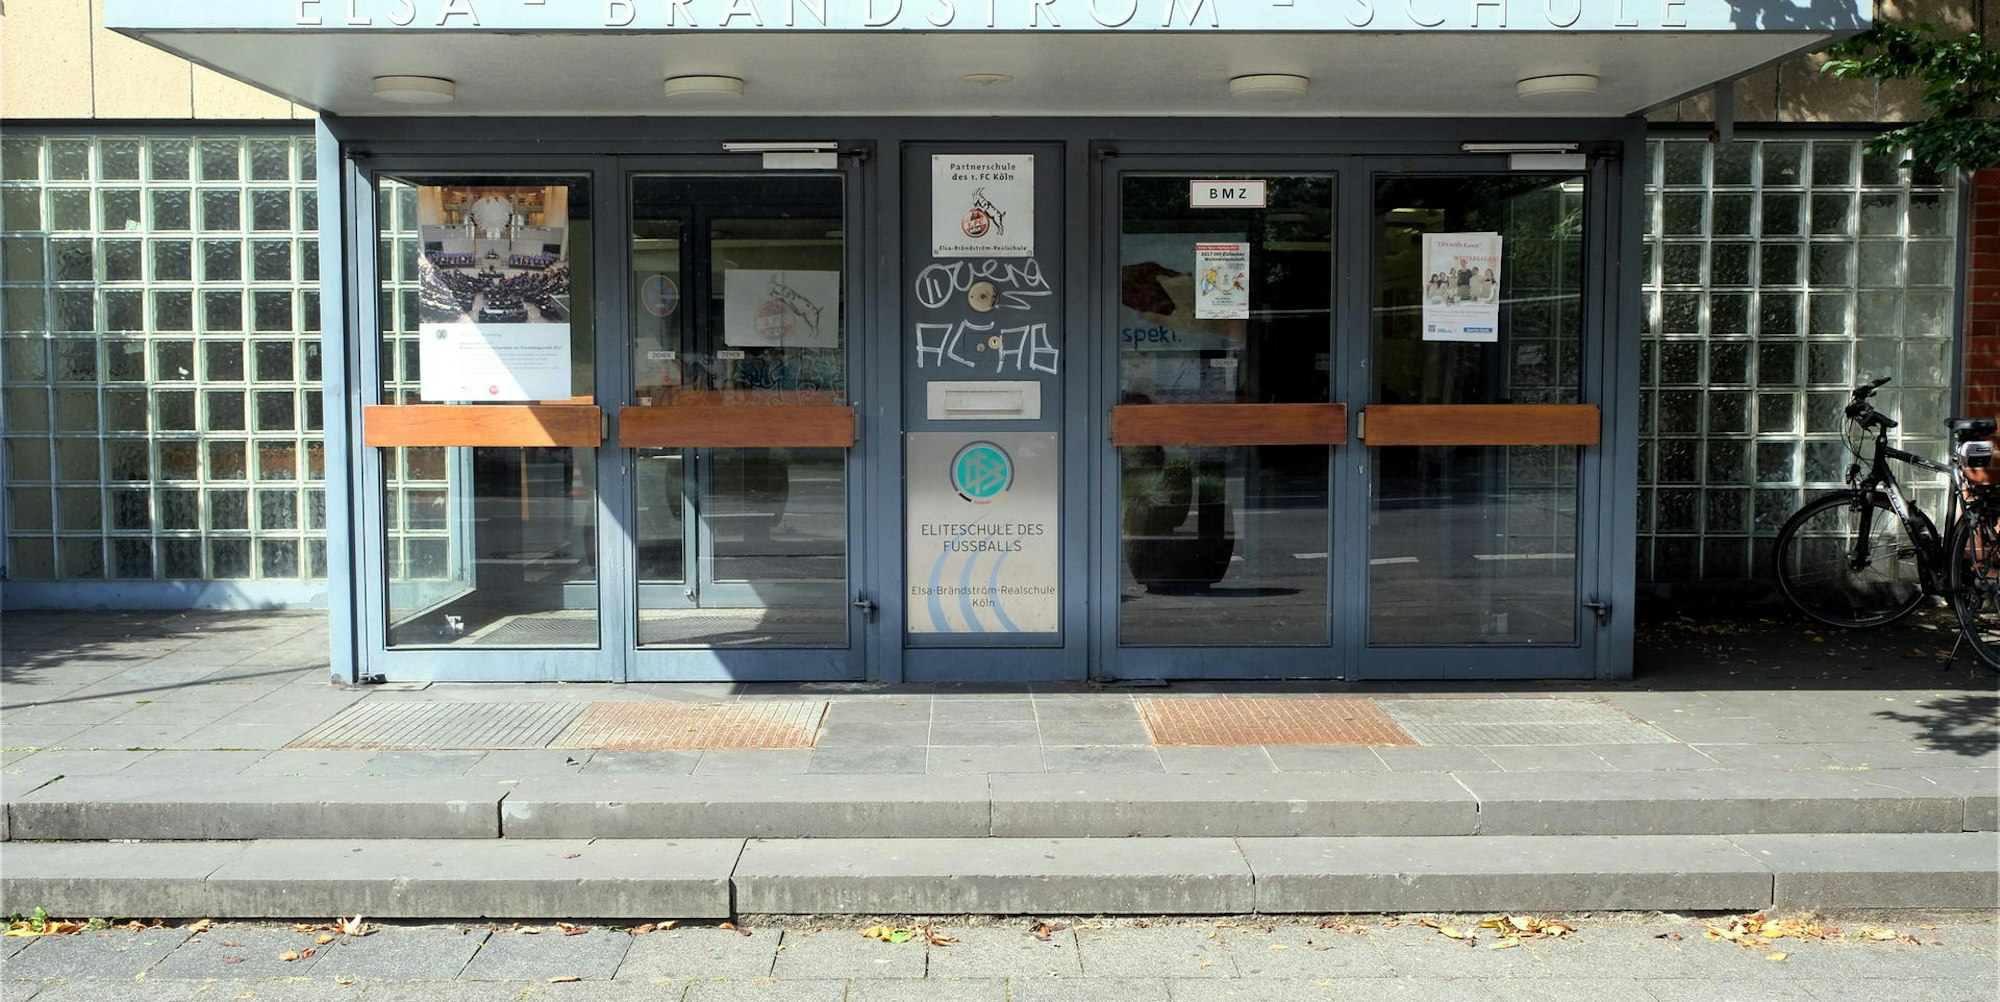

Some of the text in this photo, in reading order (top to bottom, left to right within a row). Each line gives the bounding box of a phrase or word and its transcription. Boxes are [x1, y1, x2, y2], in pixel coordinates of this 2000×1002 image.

[949, 162, 1016, 171] Partnerschule
[951, 172, 968, 181] des
[980, 173, 991, 181] FC
[993, 172, 1015, 181] Köln
[921, 523, 1044, 536] ELITESCHULE DES
[943, 540, 1022, 552] FUSSBALLS
[911, 585, 1056, 596] Elsa-Brändström-Realschule
[972, 597, 995, 608] Köln
